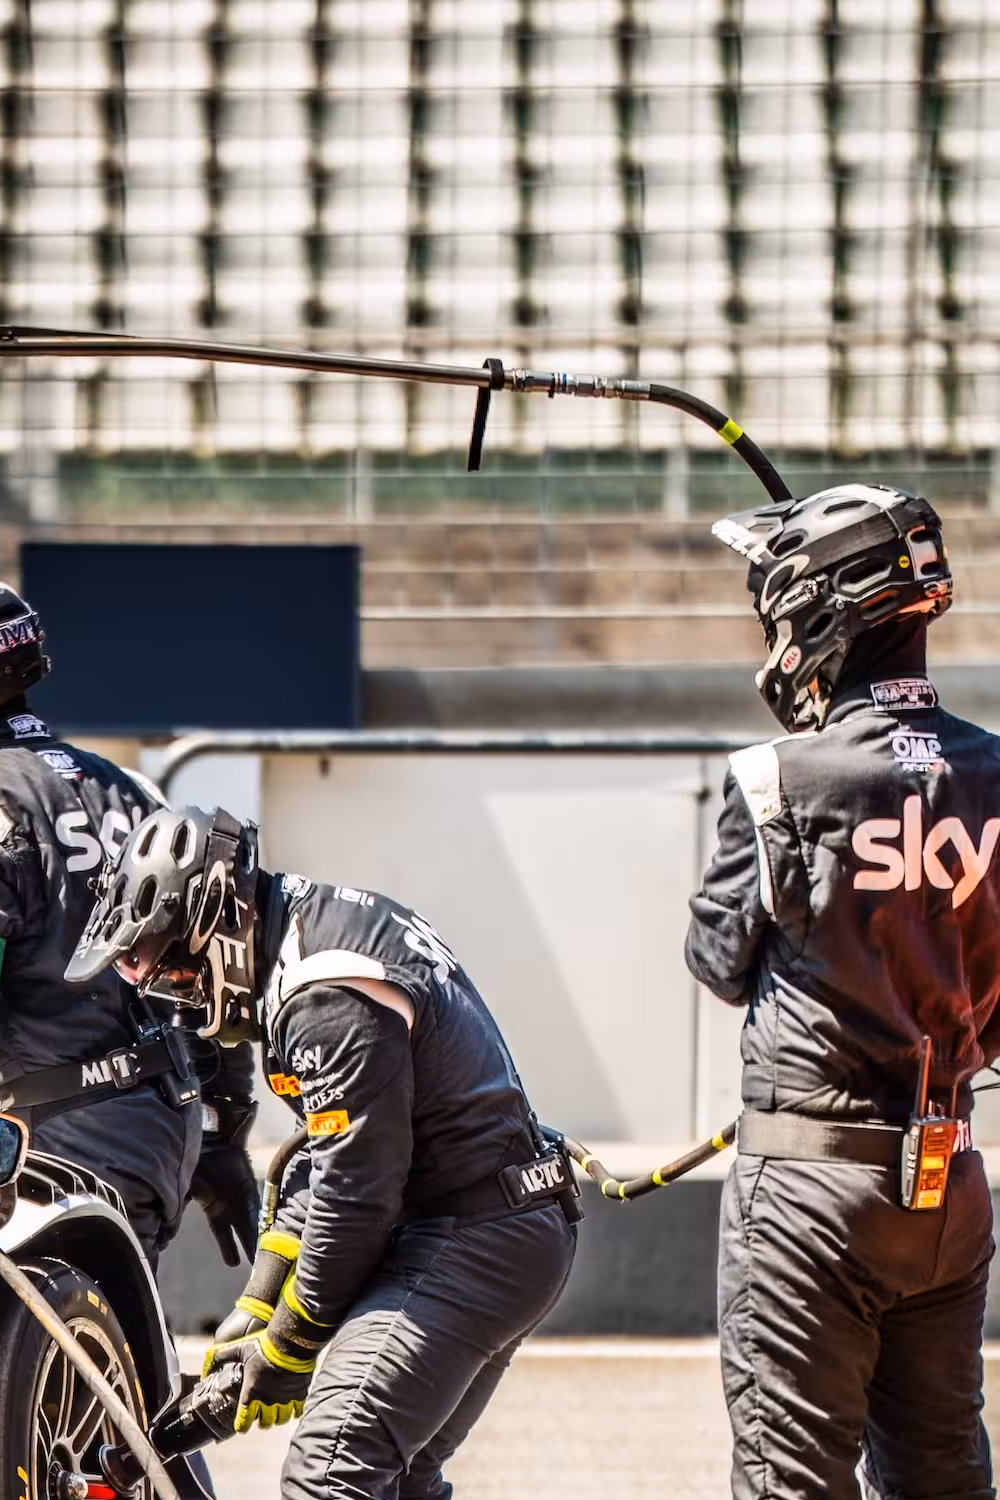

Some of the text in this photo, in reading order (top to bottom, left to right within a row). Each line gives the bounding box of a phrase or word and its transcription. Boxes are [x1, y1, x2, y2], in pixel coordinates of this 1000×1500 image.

[784, 652, 799, 669] BELL
[892, 736, 942, 759] OMP
[852, 795, 1000, 909] sky
